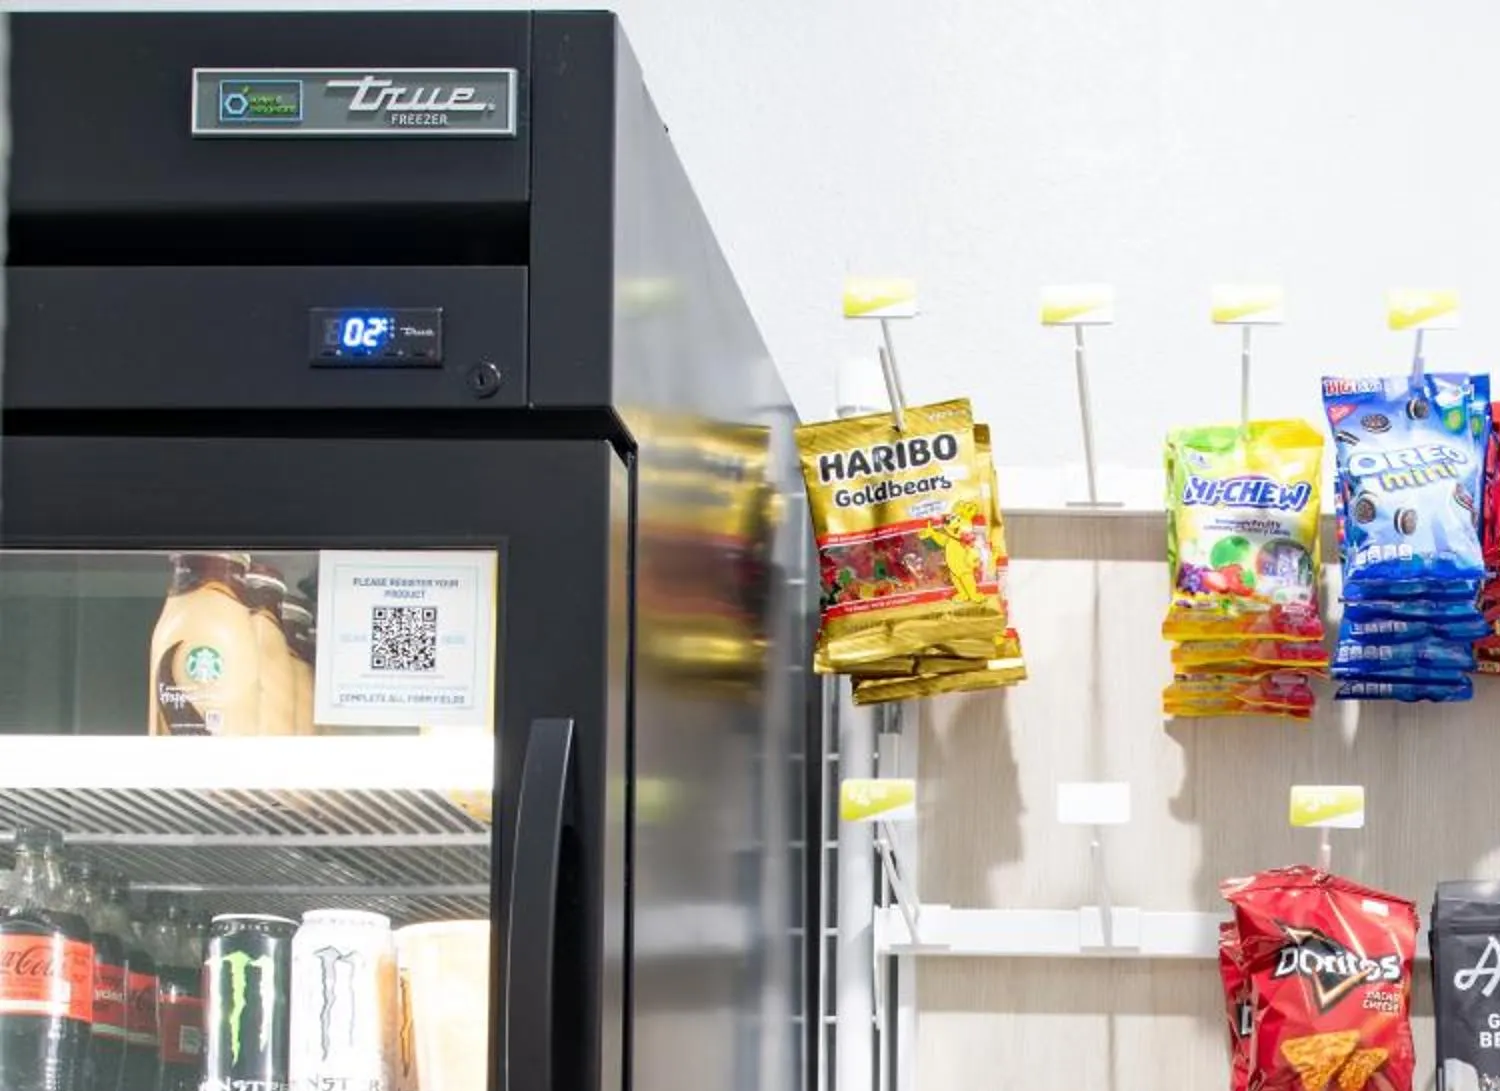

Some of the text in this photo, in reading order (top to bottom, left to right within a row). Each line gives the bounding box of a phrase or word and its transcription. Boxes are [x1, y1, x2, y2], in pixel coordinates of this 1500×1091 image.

[391, 113, 449, 125] FREEZER
[818, 433, 958, 483] HARIBO
[1349, 444, 1472, 476] OREO
[835, 473, 953, 508] Goldbears
[1274, 946, 1401, 981] Doritos
